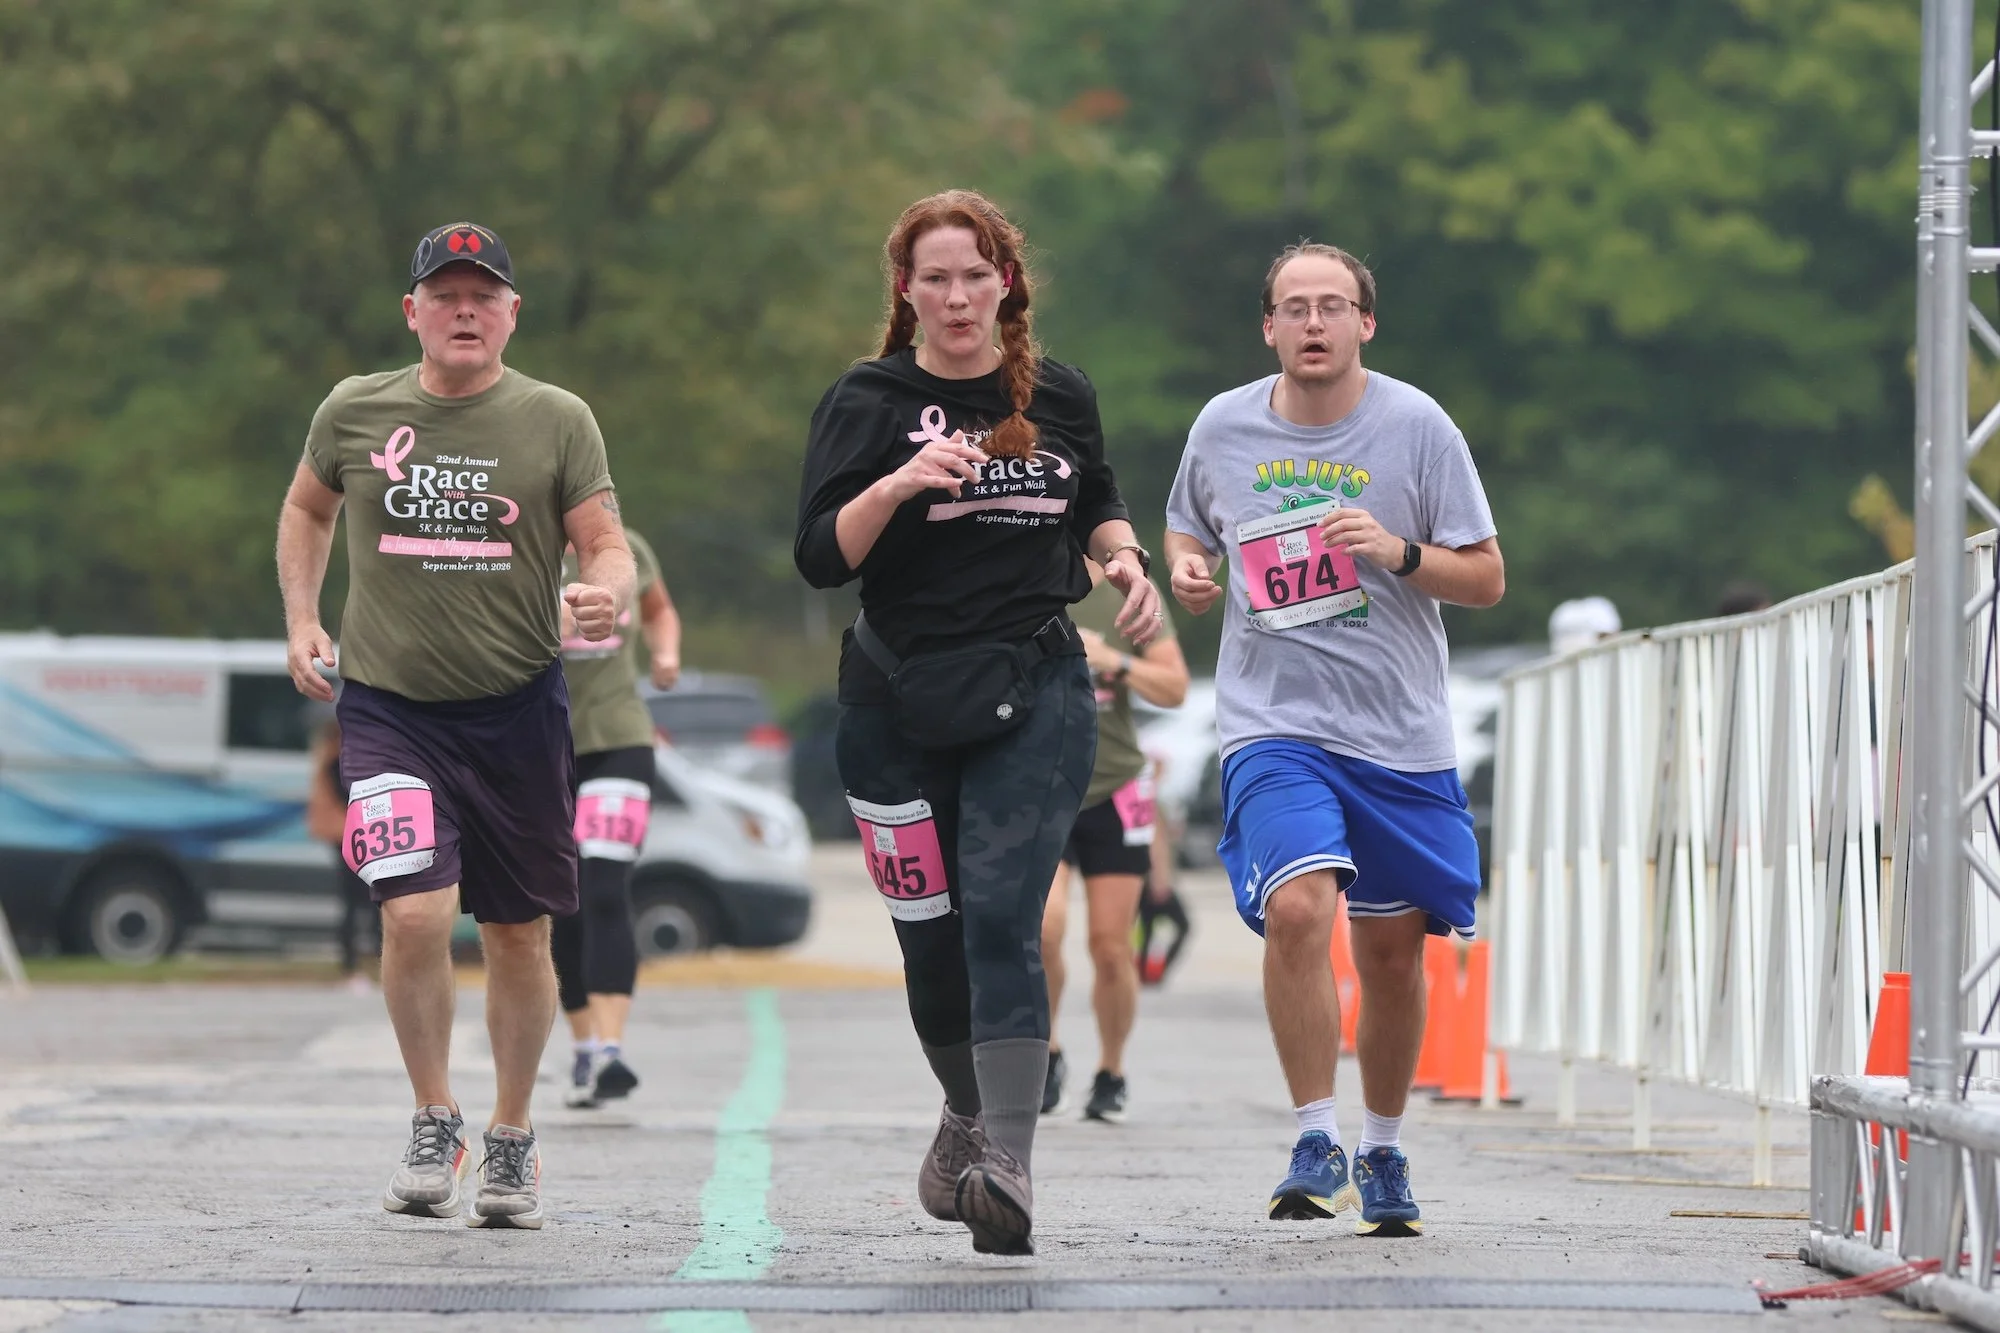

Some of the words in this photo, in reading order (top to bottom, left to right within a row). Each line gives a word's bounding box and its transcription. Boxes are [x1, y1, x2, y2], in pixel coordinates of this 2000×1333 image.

[436, 455, 461, 464] 22nd
[463, 456, 499, 467] Annual
[962, 457, 1044, 481] race
[408, 464, 489, 498] Race
[974, 485, 988, 495] 5K
[991, 484, 1000, 493] &
[1003, 483, 1022, 492] Fun
[1024, 480, 1047, 490] Walk
[1252, 459, 1370, 498] JUJU'S
[384, 485, 489, 521] Grace
[443, 490, 466, 499] With
[976, 514, 1028, 525] September
[1309, 511, 1327, 519] Medical
[418, 523, 431, 533] 5K
[434, 525, 443, 533] &
[445, 525, 463, 534] Fun
[466, 525, 488, 534] Walk
[422, 561, 474, 572] September
[475, 562, 489, 571] 20,
[491, 562, 511, 570] 2026
[1265, 553, 1340, 605] 674
[351, 816, 416, 865] 635
[871, 851, 927, 896] 645
